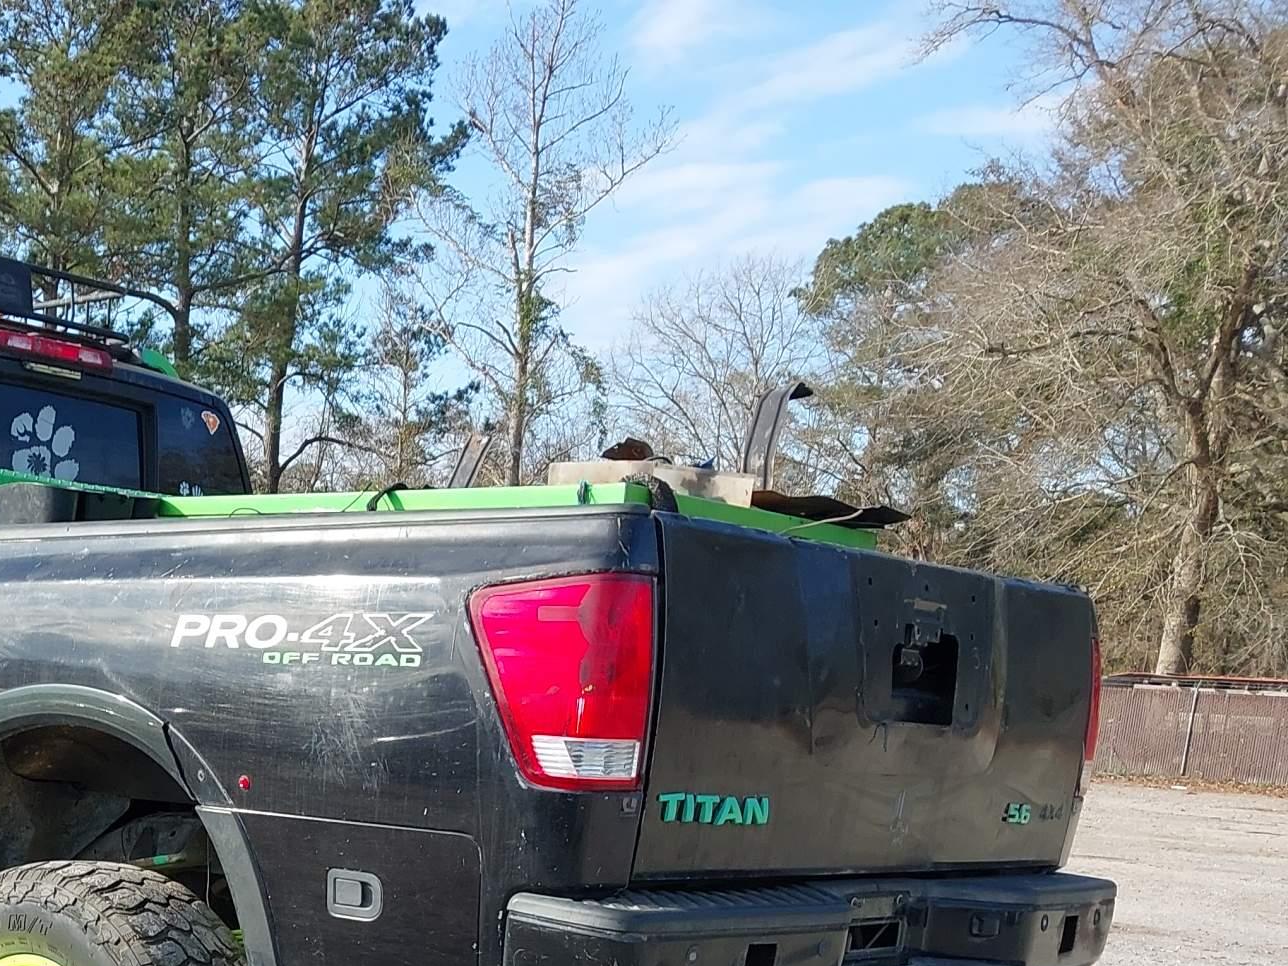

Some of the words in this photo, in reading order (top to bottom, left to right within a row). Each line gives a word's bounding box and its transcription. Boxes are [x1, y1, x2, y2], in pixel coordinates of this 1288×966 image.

[263, 652, 320, 665] OFF
[331, 653, 422, 667] ROAD
[656, 792, 770, 826] TITAN
